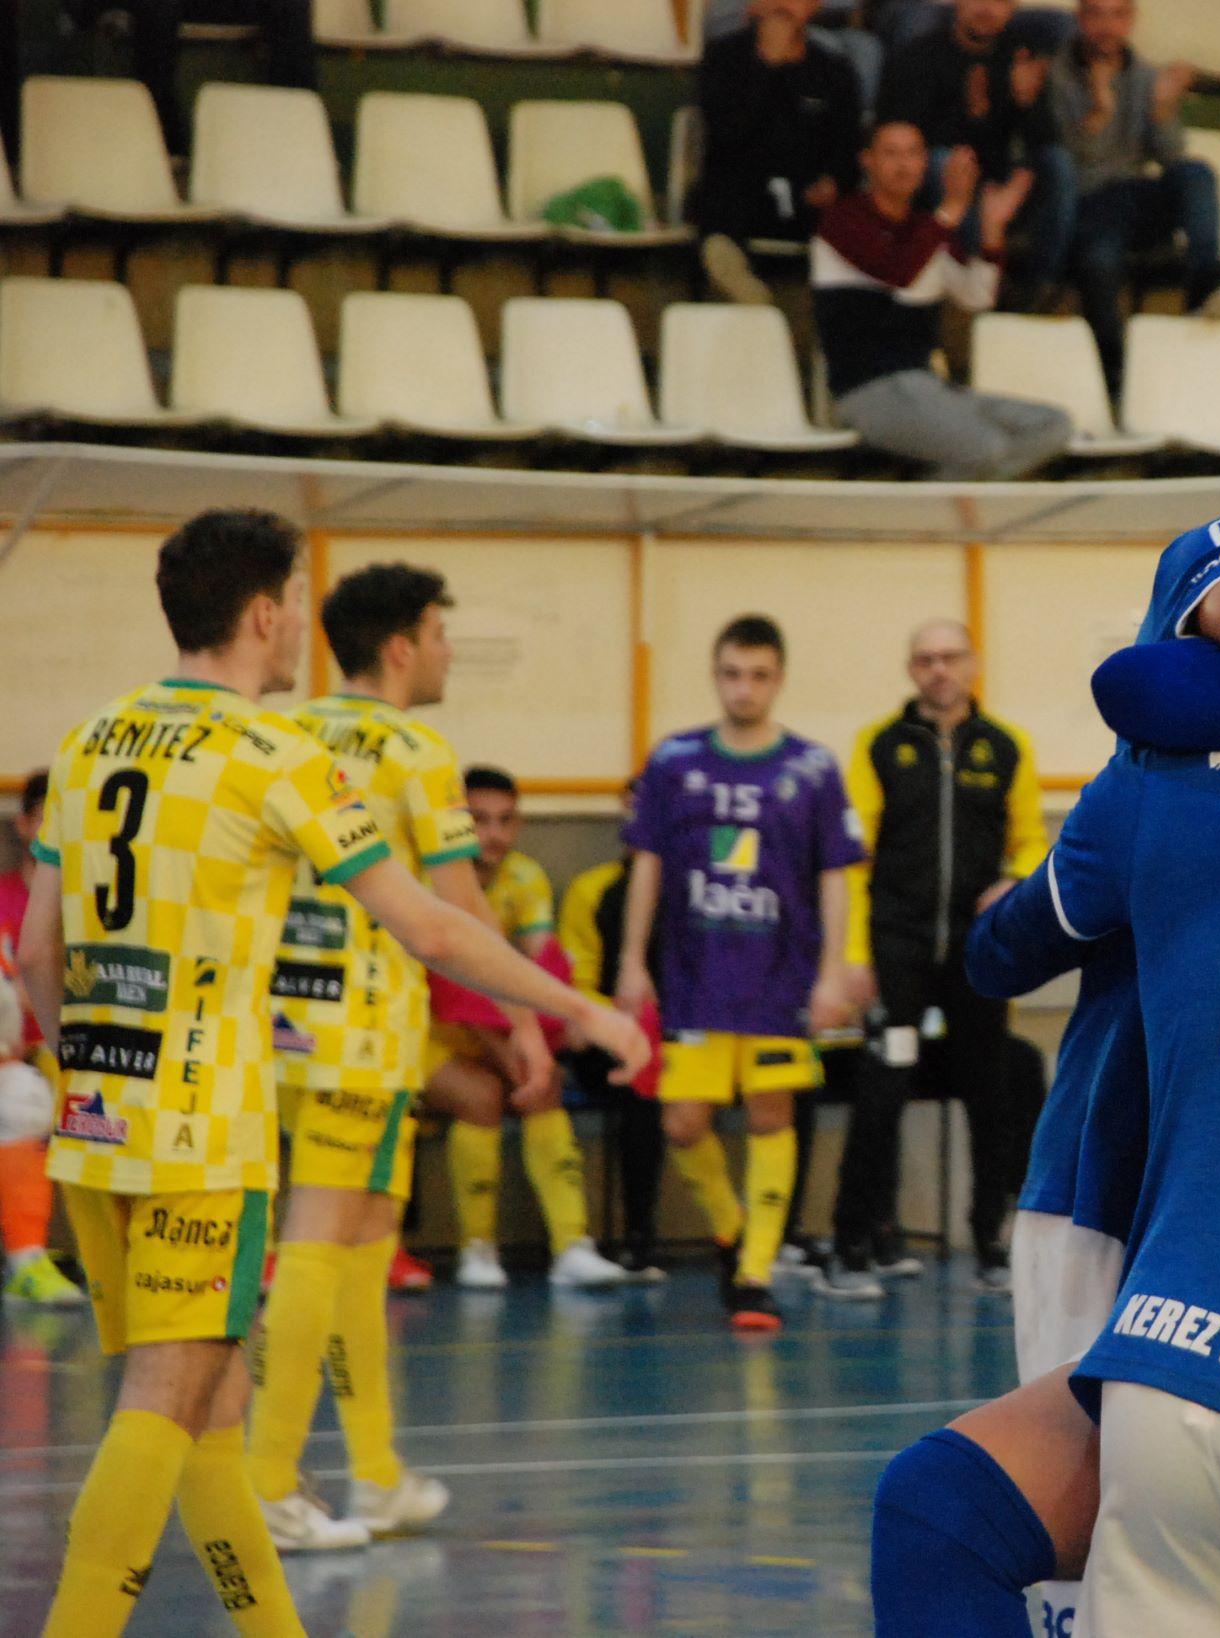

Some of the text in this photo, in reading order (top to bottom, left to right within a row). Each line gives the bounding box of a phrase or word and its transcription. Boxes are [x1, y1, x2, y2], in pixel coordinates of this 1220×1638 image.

[83, 716, 212, 763] BENITEZ
[712, 782, 763, 822] 15
[95, 769, 150, 931] 3
